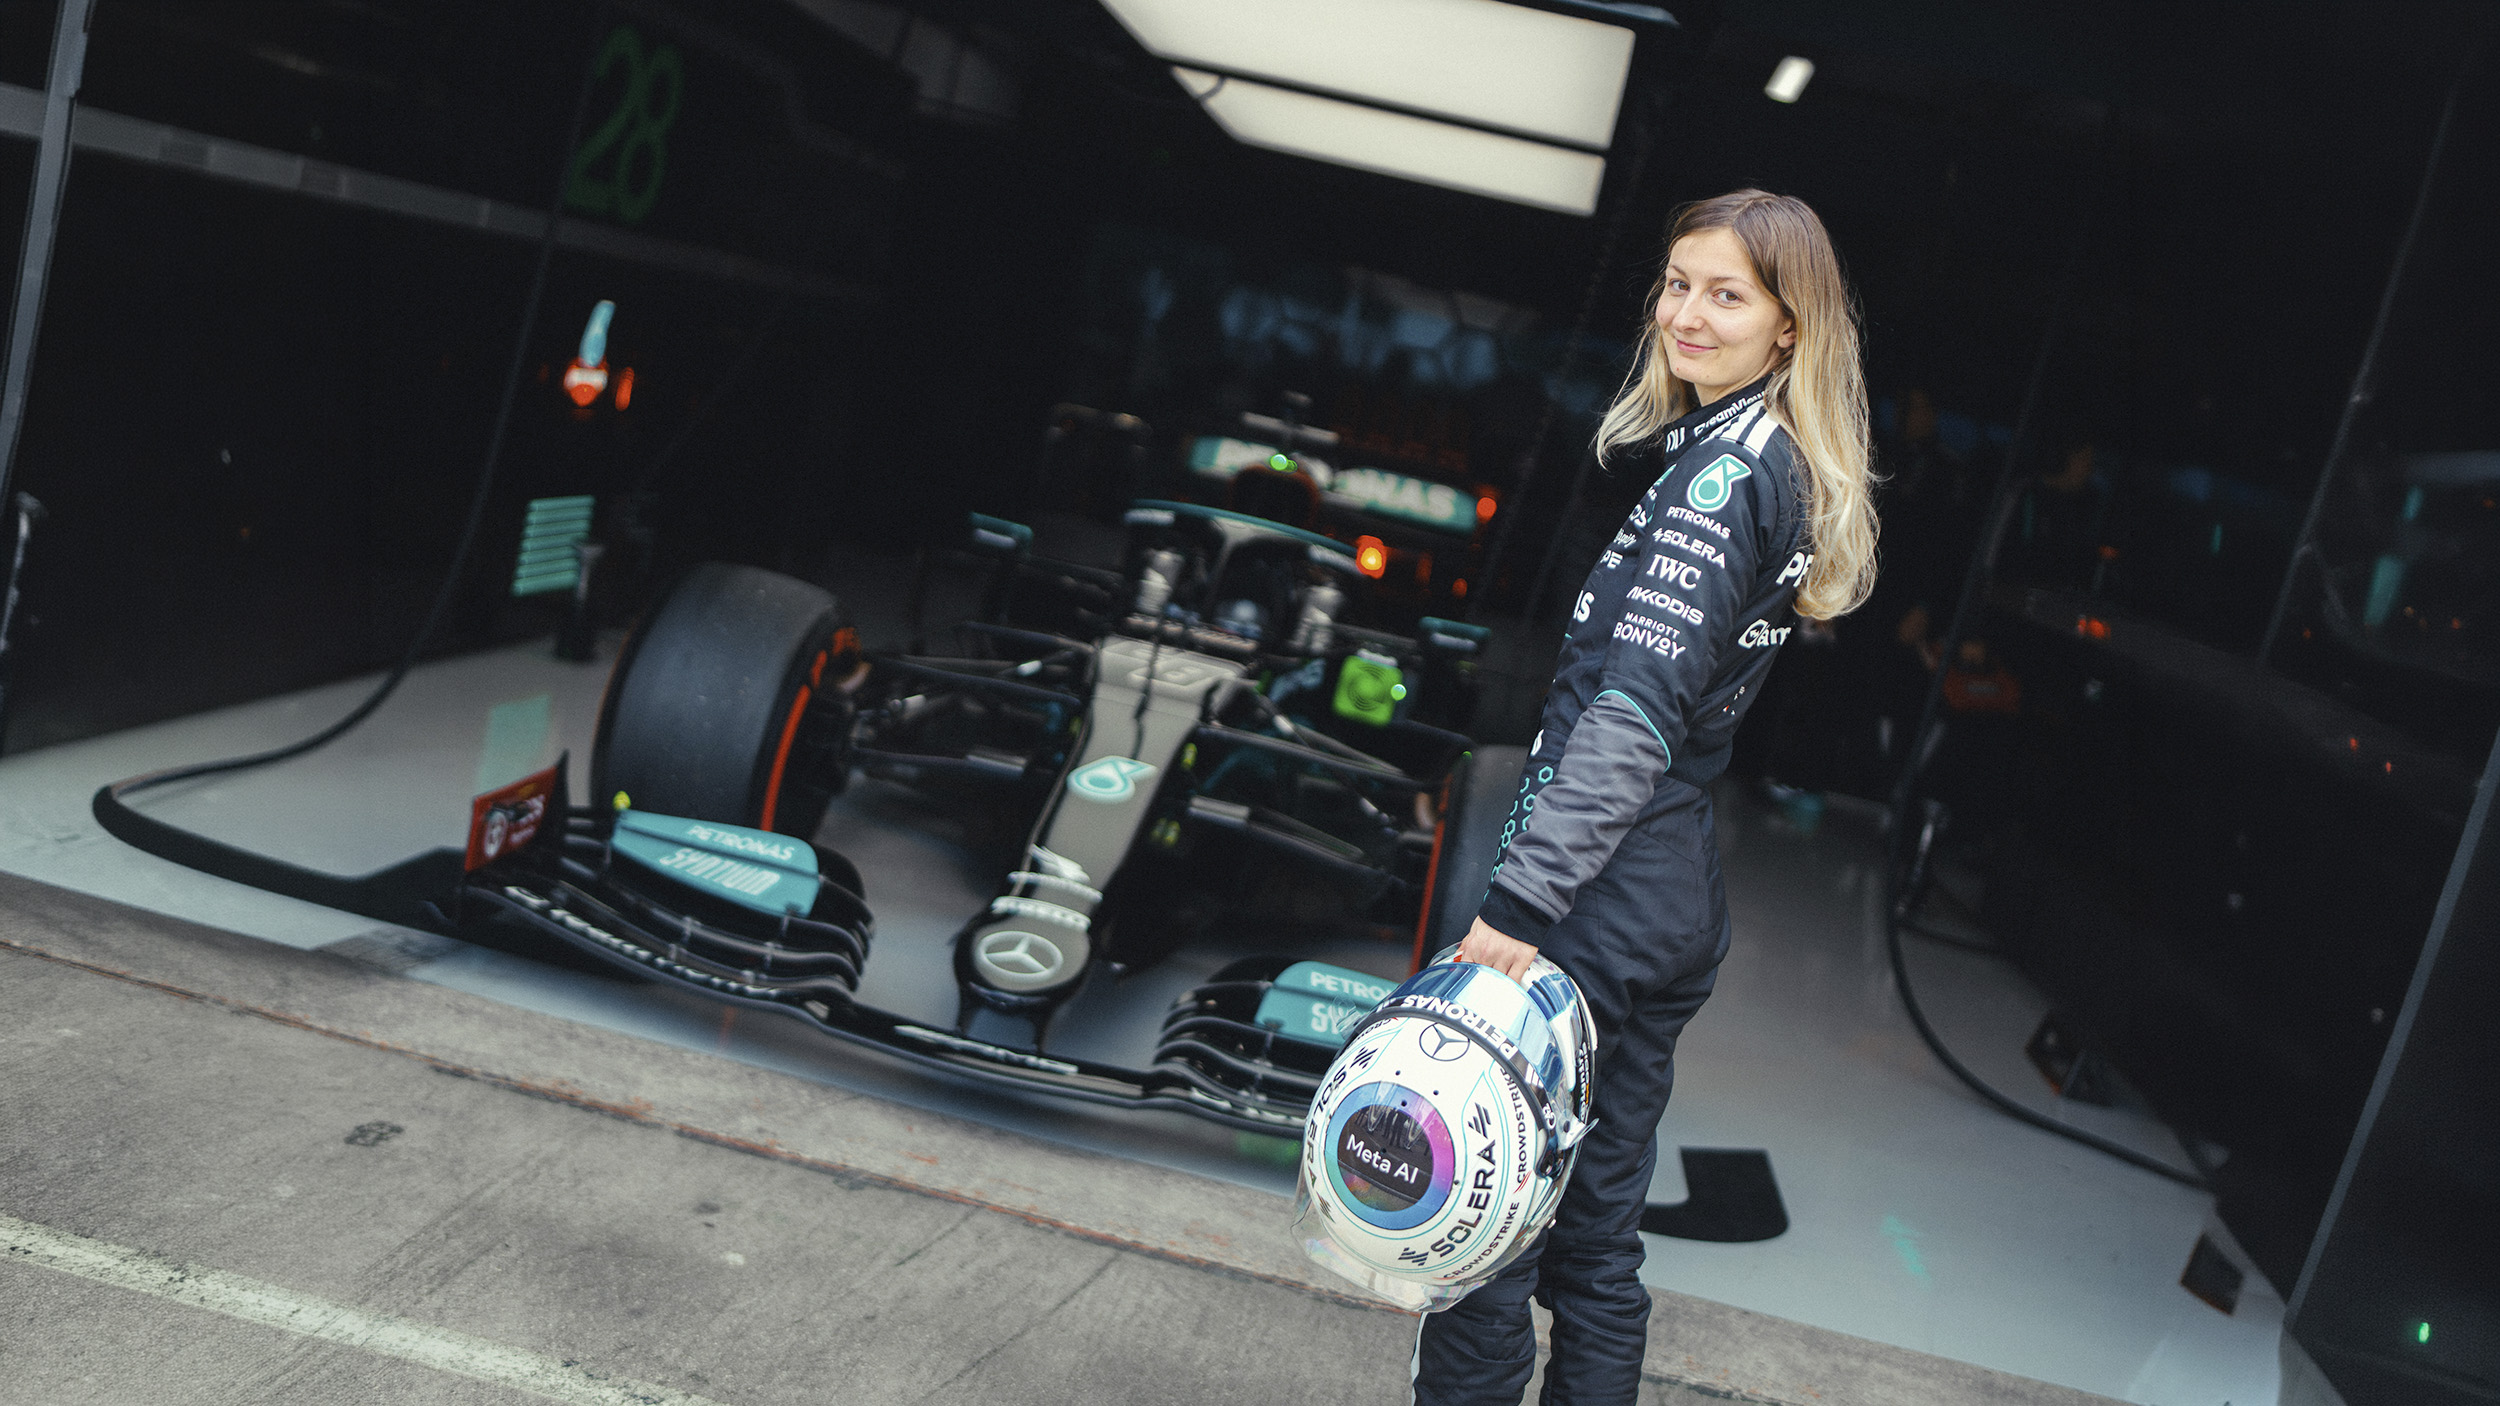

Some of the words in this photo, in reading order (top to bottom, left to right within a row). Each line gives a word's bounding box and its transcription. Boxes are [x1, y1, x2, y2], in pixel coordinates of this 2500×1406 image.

[565, 25, 685, 223] 28
[1666, 505, 1732, 540] PETRONAS
[1646, 553, 1702, 590] IWC
[1660, 528, 1726, 569] SOLERA
[1613, 621, 1687, 661] BONVOY
[1624, 611, 1681, 640] MARRIOTT
[687, 825, 795, 861] PETRONAS
[1310, 971, 1391, 1002] PETRO
[1401, 994, 1519, 1061] PETRONAS
[1306, 1064, 1348, 1189] SOLERA
[1499, 1067, 1527, 1184] CROWDSTRIKE
[1346, 1133, 1392, 1174] Meta
[1393, 1162, 1419, 1185] AI
[1430, 1139, 1496, 1258] SOLERA
[1443, 1201, 1520, 1278] CROWDSTRIKE
